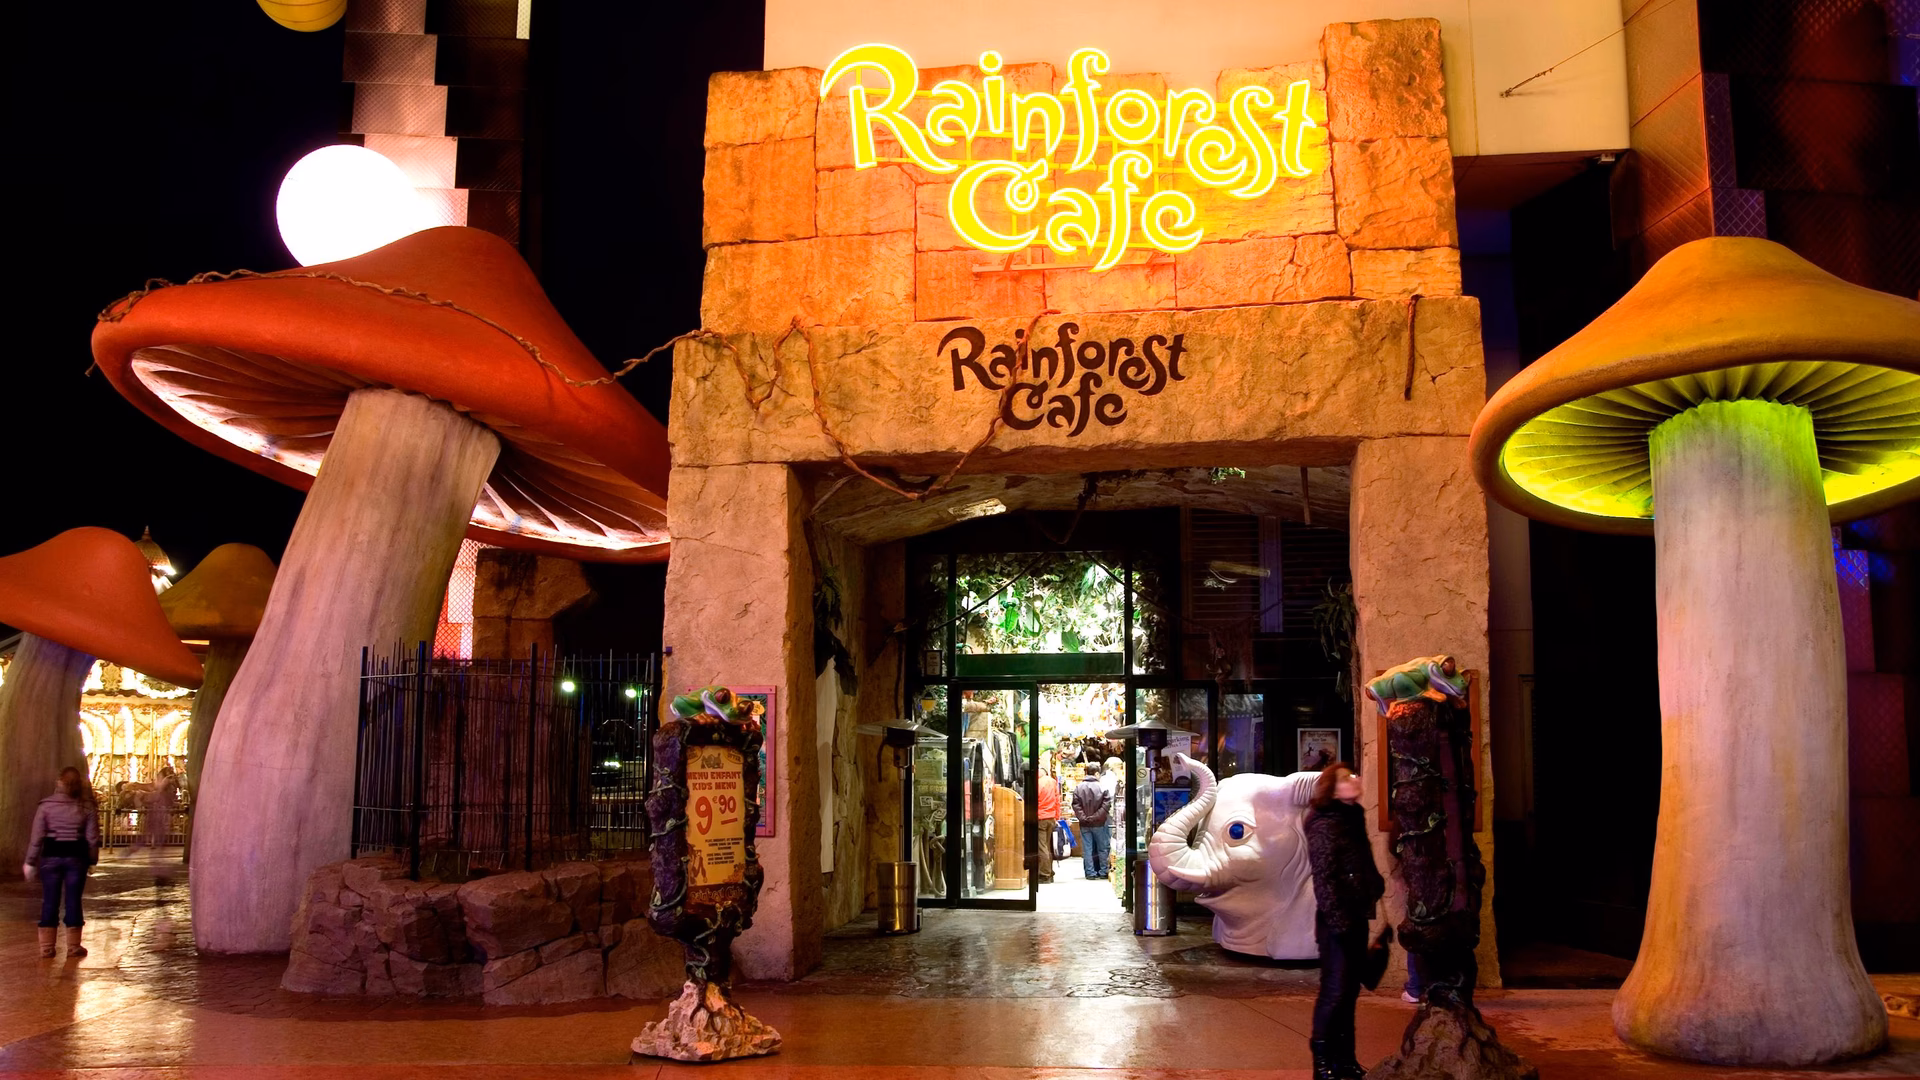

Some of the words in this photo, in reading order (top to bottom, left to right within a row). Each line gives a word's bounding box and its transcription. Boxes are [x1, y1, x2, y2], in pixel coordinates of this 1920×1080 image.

[819, 43, 1317, 201] Rainforest
[947, 149, 1205, 273] Cafe
[936, 322, 1189, 397] Rainforest
[1000, 372, 1128, 437] Cafe
[687, 771, 709, 780] MENU
[710, 771, 742, 780] ENFANT
[714, 781, 737, 790] MENU
